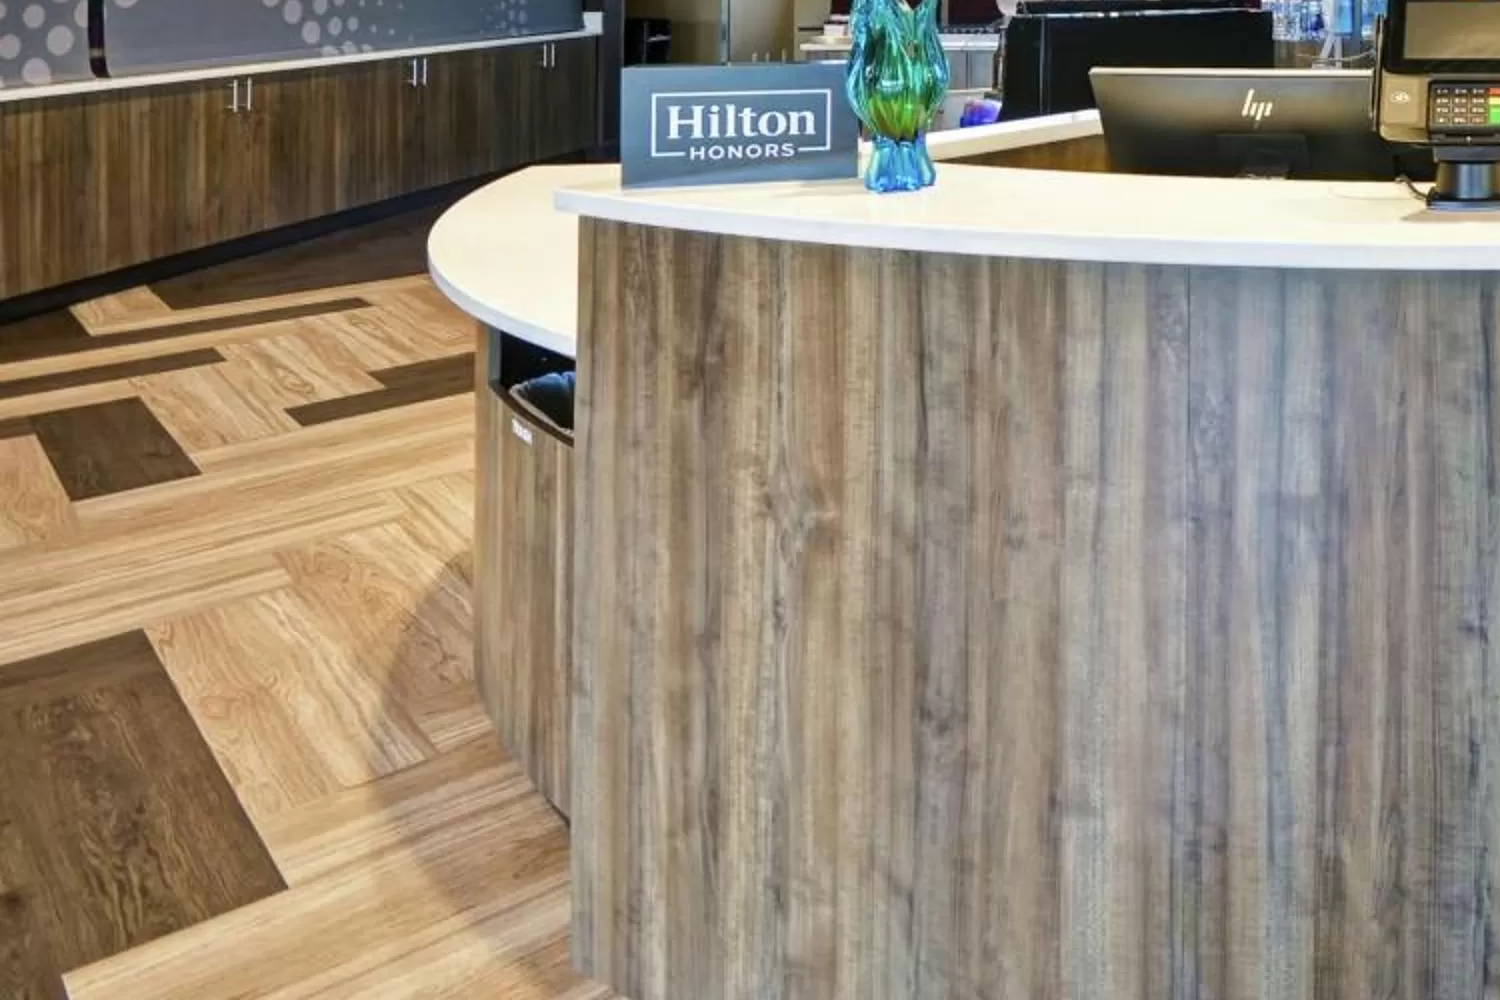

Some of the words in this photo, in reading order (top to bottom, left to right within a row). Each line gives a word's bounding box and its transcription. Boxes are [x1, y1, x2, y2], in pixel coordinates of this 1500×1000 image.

[667, 103, 816, 140] Hilton
[1241, 88, 1273, 128] hp
[689, 142, 795, 161] HONORS
